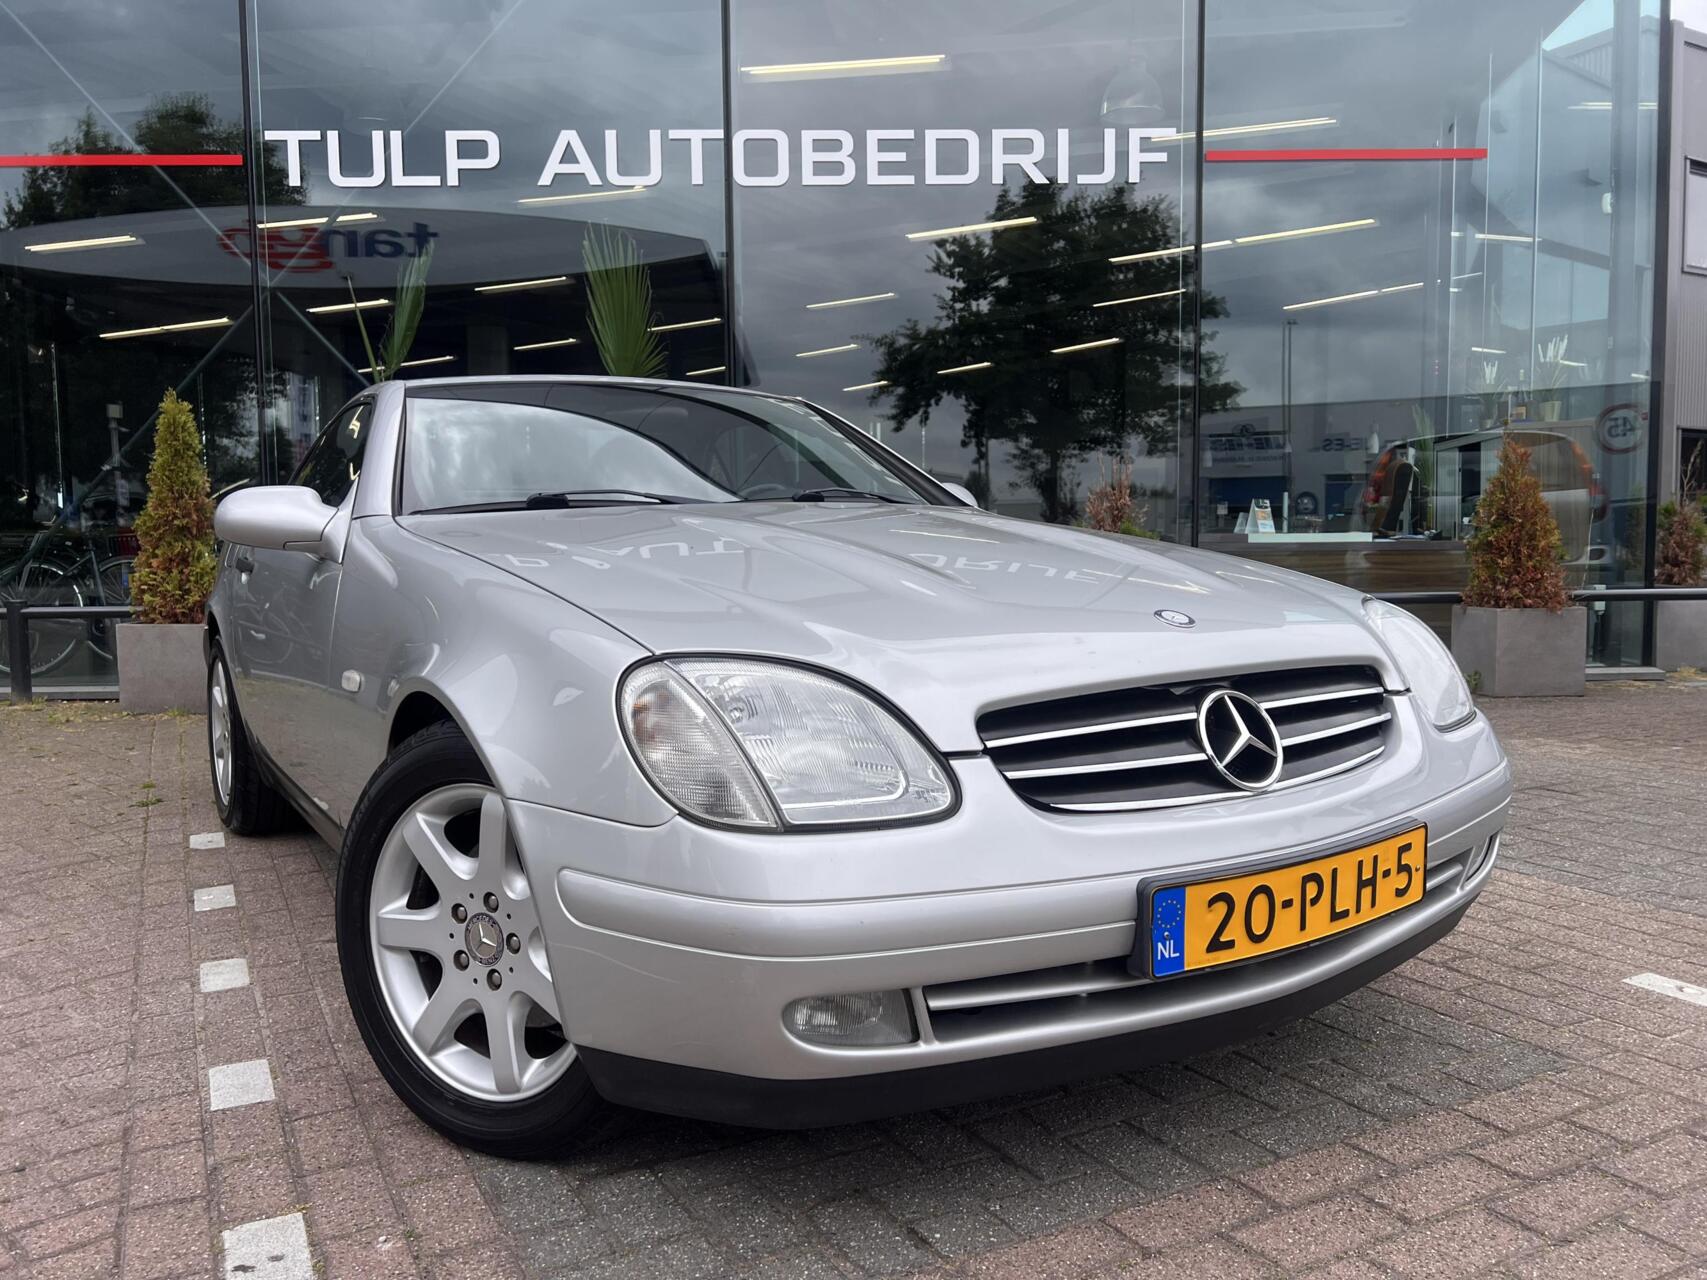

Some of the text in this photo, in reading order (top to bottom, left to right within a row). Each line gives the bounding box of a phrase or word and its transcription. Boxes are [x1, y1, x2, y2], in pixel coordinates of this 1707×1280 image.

[264, 127, 1177, 187] TULP AUTOBEDRIJF
[1205, 842, 1413, 954] 20-PLH-5
[1157, 939, 1180, 961] NL
